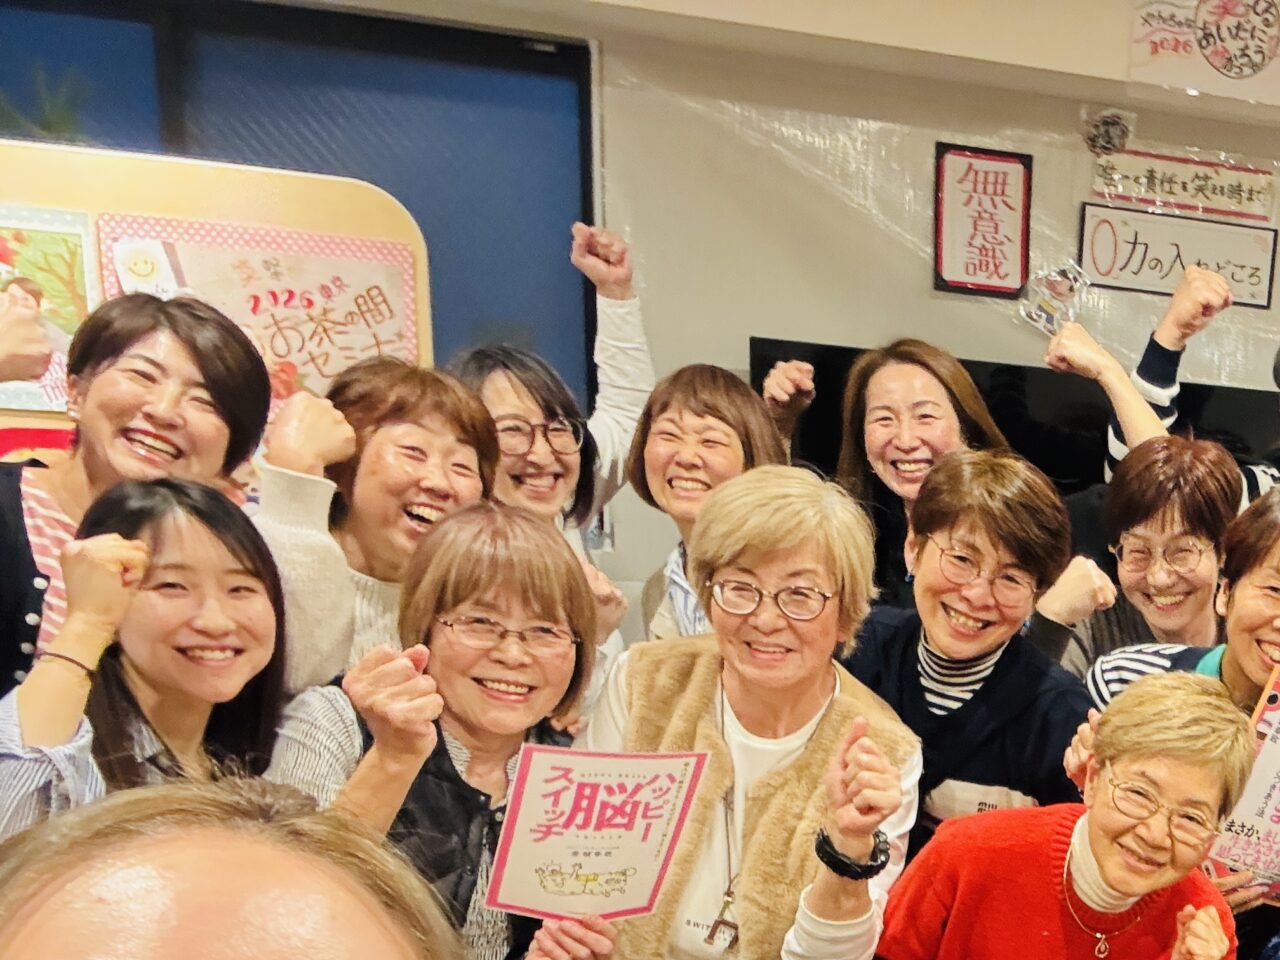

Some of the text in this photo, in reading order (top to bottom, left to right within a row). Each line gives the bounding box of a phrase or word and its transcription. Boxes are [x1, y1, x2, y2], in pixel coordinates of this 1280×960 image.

[957, 162, 1016, 280] 無意識
[529, 766, 575, 842] スイッチ
[561, 782, 643, 831] 脳
[641, 773, 677, 842] ハッピー
